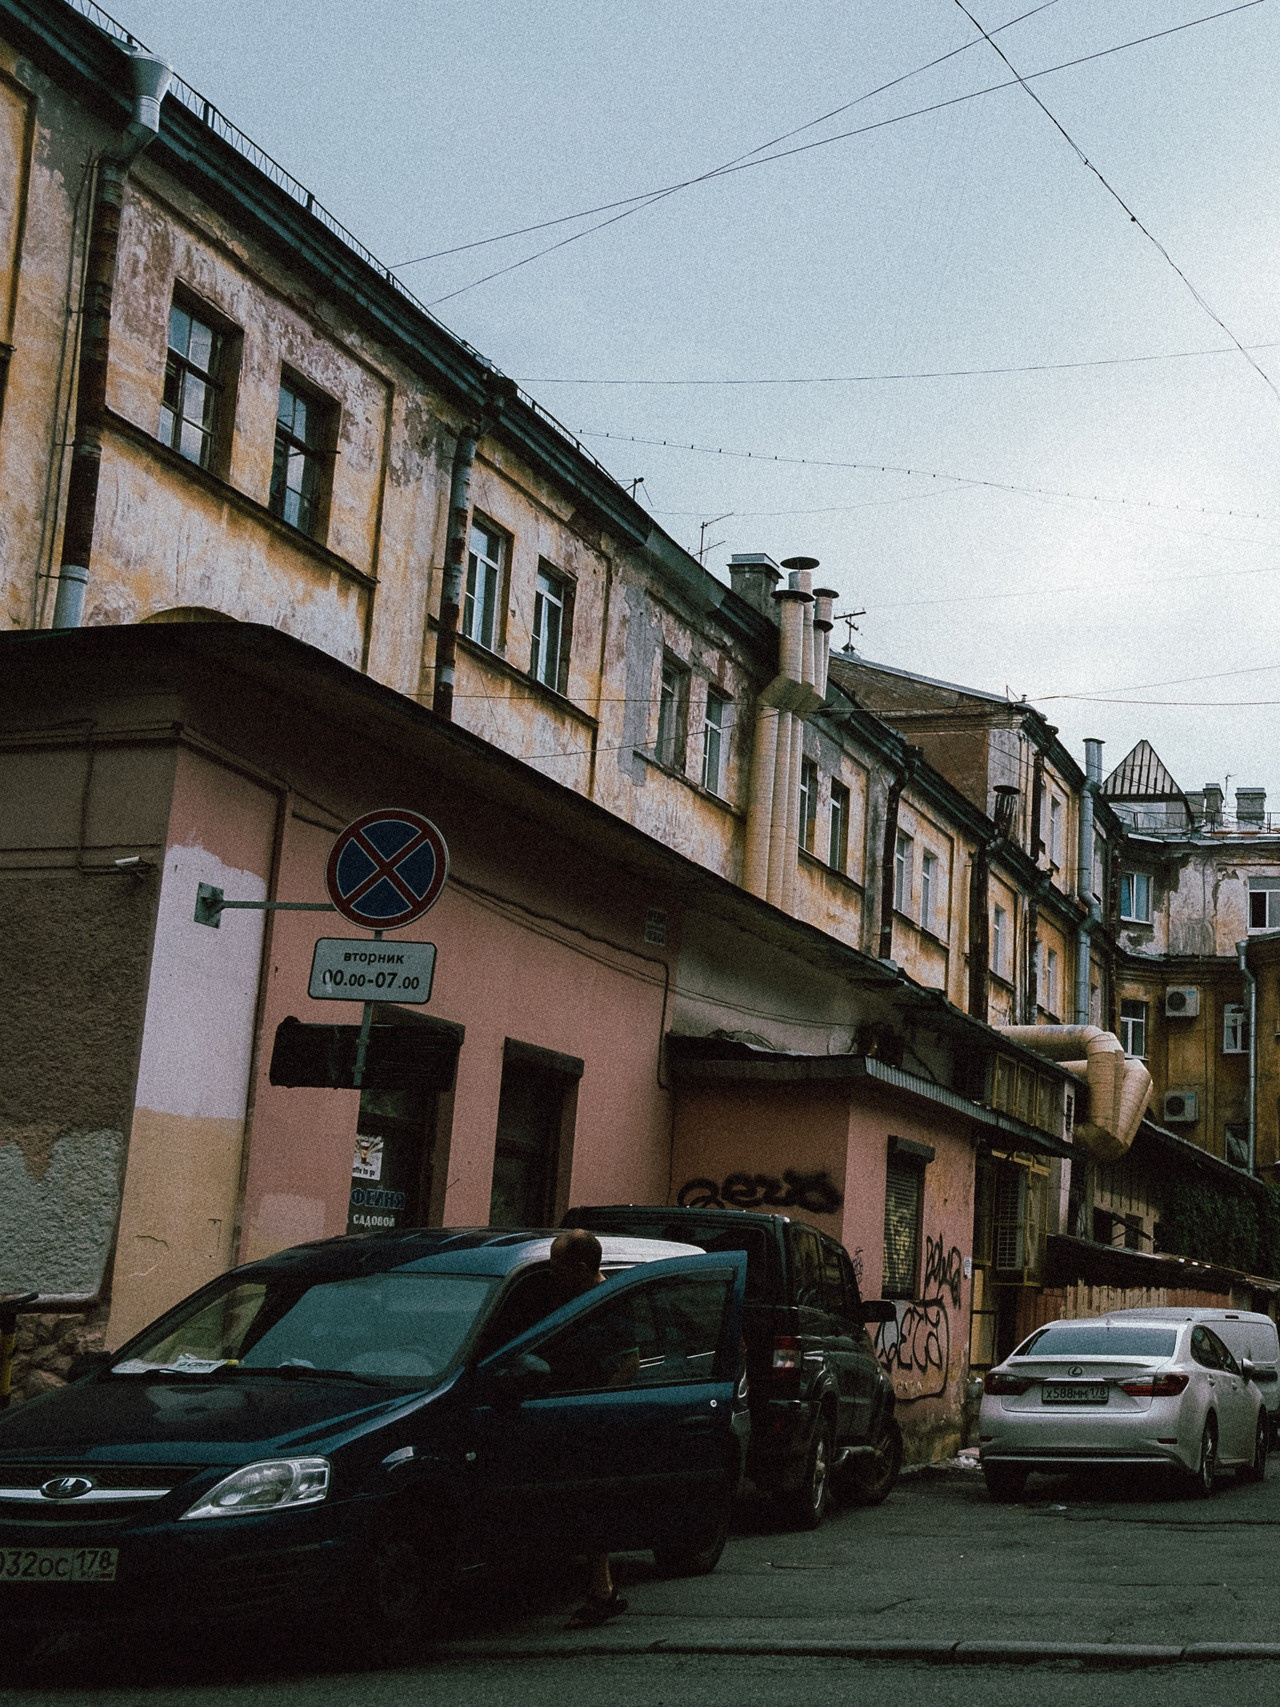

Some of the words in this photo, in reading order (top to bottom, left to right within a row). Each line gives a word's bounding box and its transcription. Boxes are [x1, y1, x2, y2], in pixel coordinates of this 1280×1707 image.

[343, 952, 404, 965] вторник
[352, 1213, 396, 1228] САДОВОЙ
[76, 1550, 112, 1571] 178
